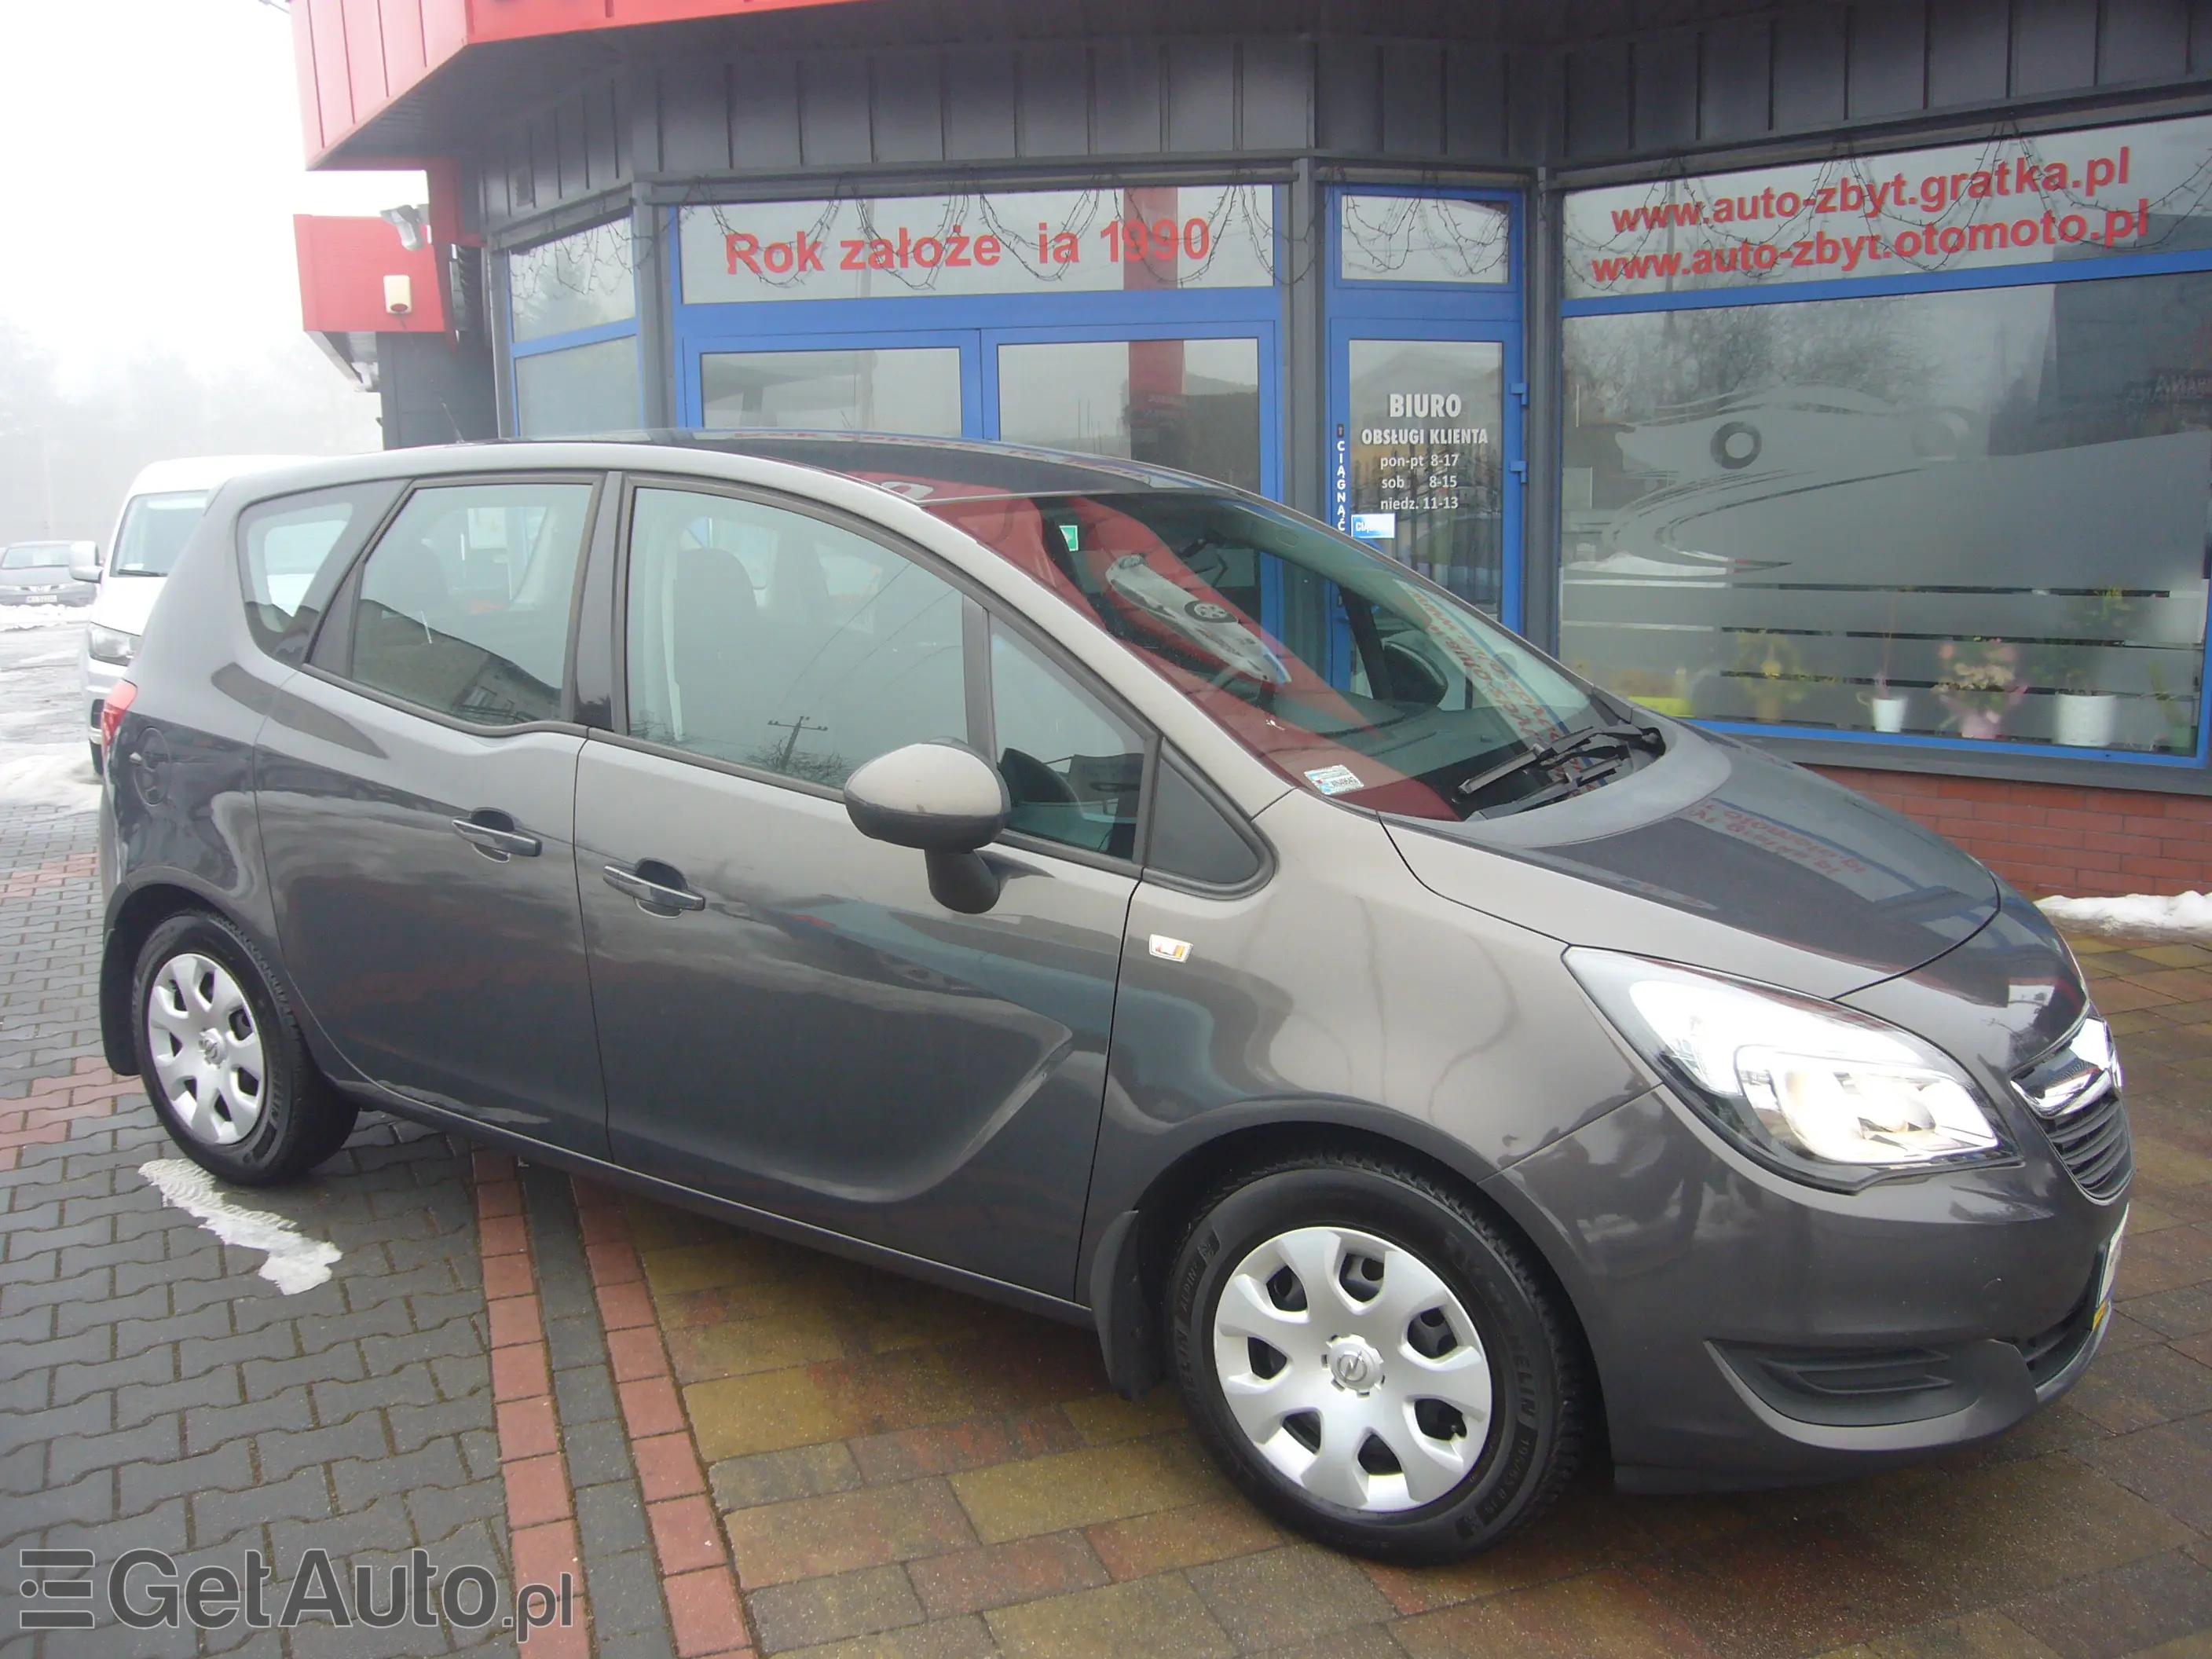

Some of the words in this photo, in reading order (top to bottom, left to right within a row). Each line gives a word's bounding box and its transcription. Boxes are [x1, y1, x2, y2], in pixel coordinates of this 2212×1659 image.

[1610, 146, 2130, 233] www.auto-zbyt.gratka.pl
[726, 231, 824, 275] Rok
[1101, 218, 1210, 263] 1990
[1591, 198, 2148, 283] www.auto-zbyt.otomoto.pl
[1390, 394, 1462, 418] BIURO
[1361, 429, 1424, 445] OBSŁUGI
[1430, 429, 1489, 445] KLIENTA
[1380, 455, 1424, 470] pon-pt
[1430, 453, 1459, 467] 8-17
[1382, 474, 1404, 489] sob
[1429, 474, 1457, 488] 8-15
[1380, 496, 1419, 511] niedz.
[1423, 496, 1459, 510] 11-13
